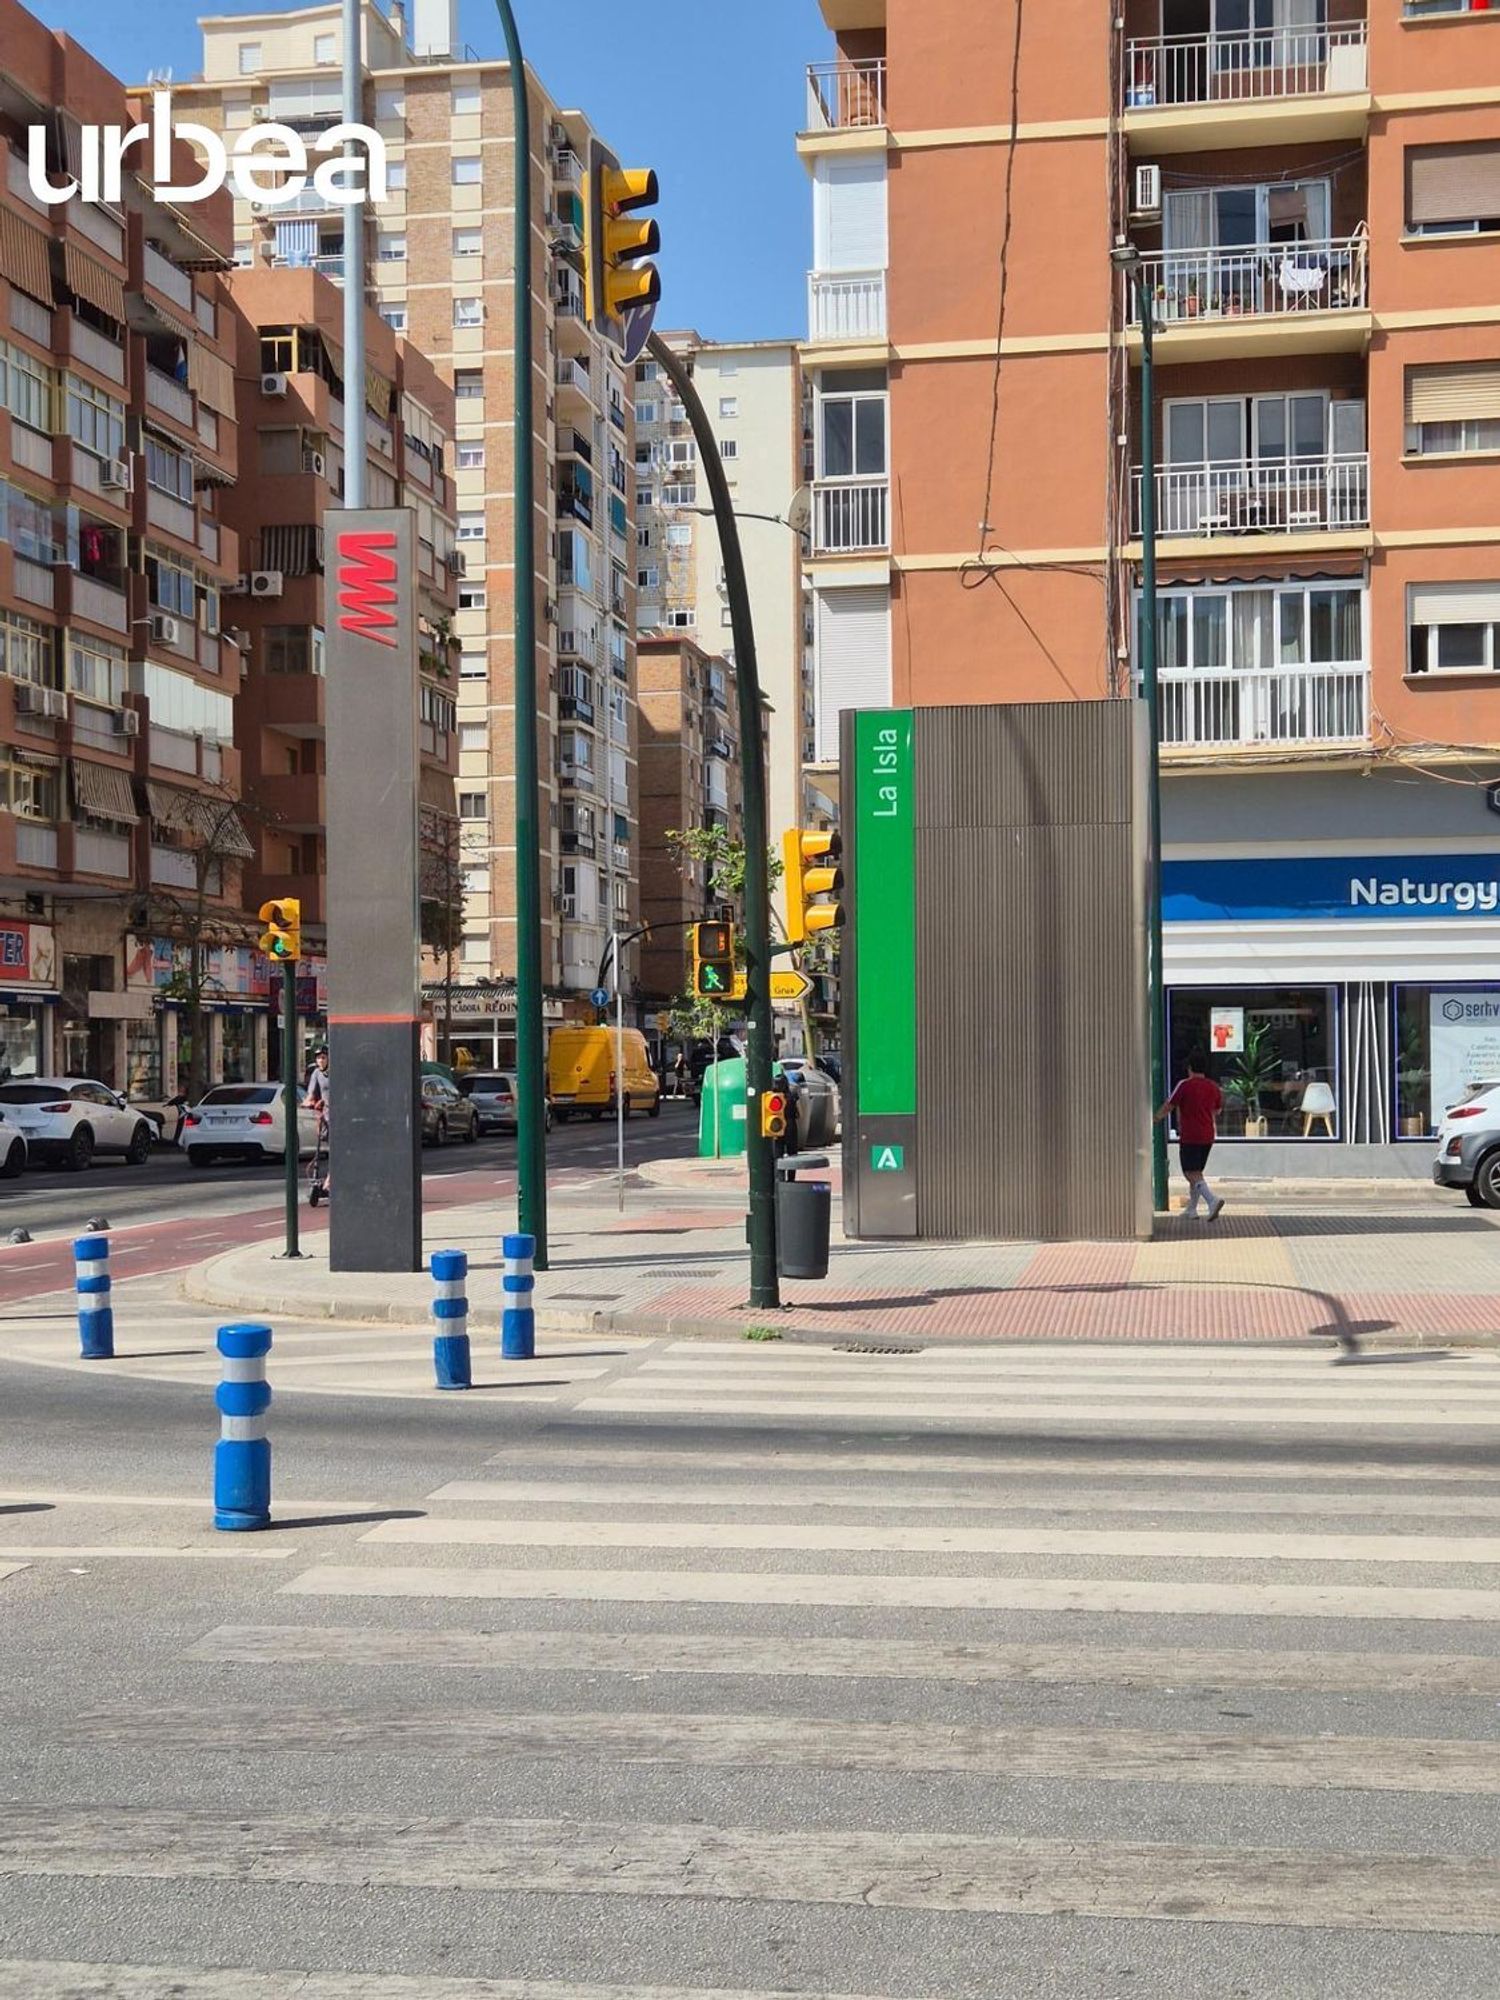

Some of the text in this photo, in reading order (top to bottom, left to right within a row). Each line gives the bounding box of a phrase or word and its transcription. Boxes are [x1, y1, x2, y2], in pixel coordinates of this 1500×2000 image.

[873, 729, 898, 816] La Isla
[1350, 877, 1498, 912] Naturgy
